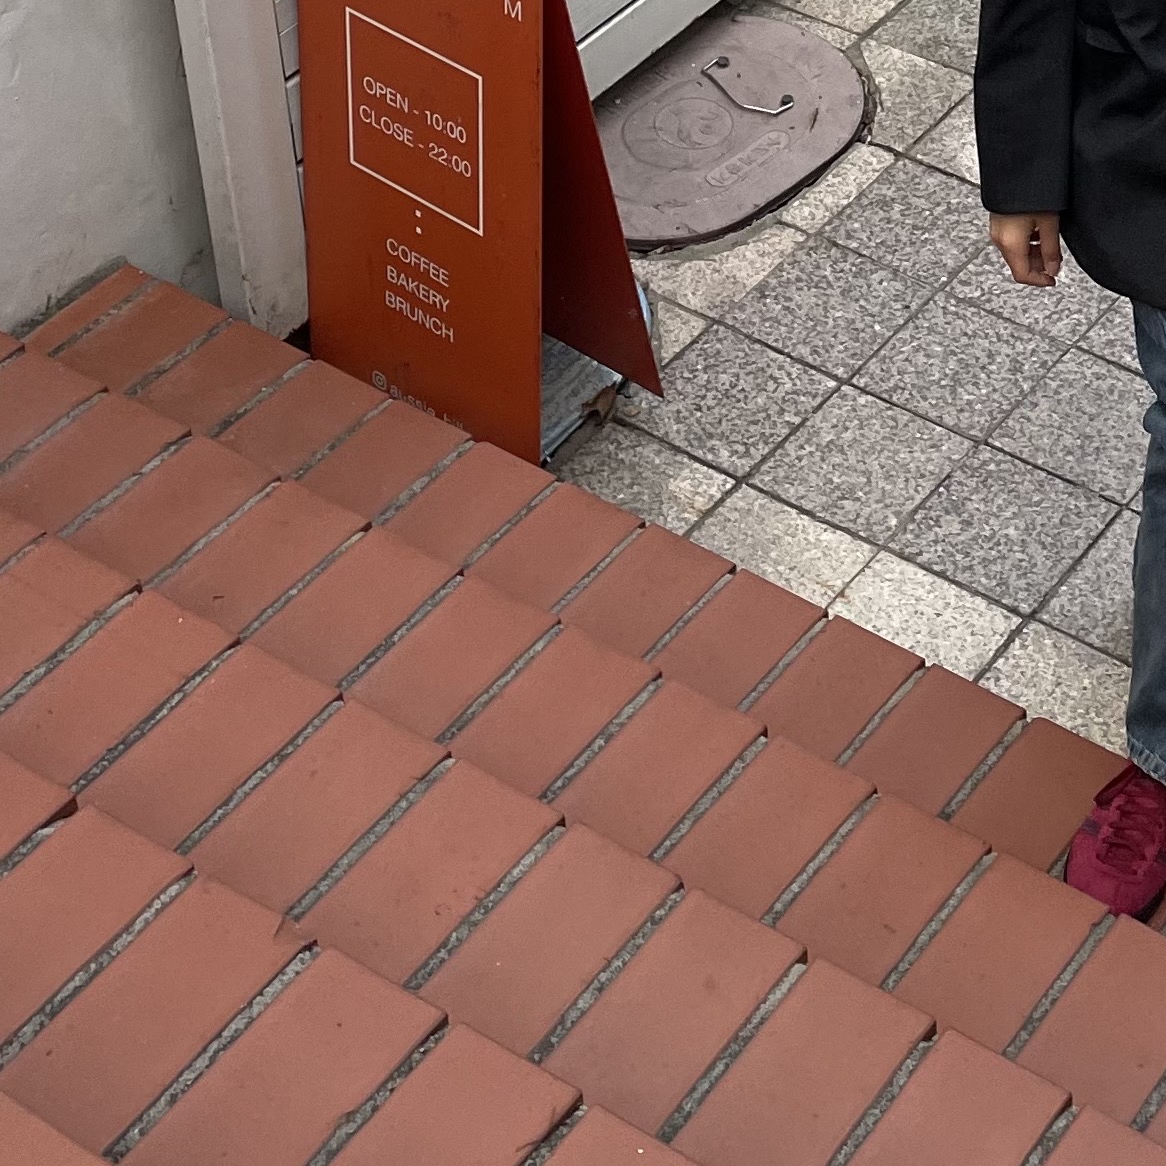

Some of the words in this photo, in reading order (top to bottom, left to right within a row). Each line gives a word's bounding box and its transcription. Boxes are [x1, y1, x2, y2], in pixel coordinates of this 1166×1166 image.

[363, 76, 409, 114] OPEN
[424, 110, 467, 144] 10:00
[359, 105, 414, 148] CLOSE
[428, 142, 472, 178] 22:00
[386, 238, 449, 288] COFFEE
[386, 265, 450, 313] BAKERY
[385, 290, 454, 343] BRUNCH
